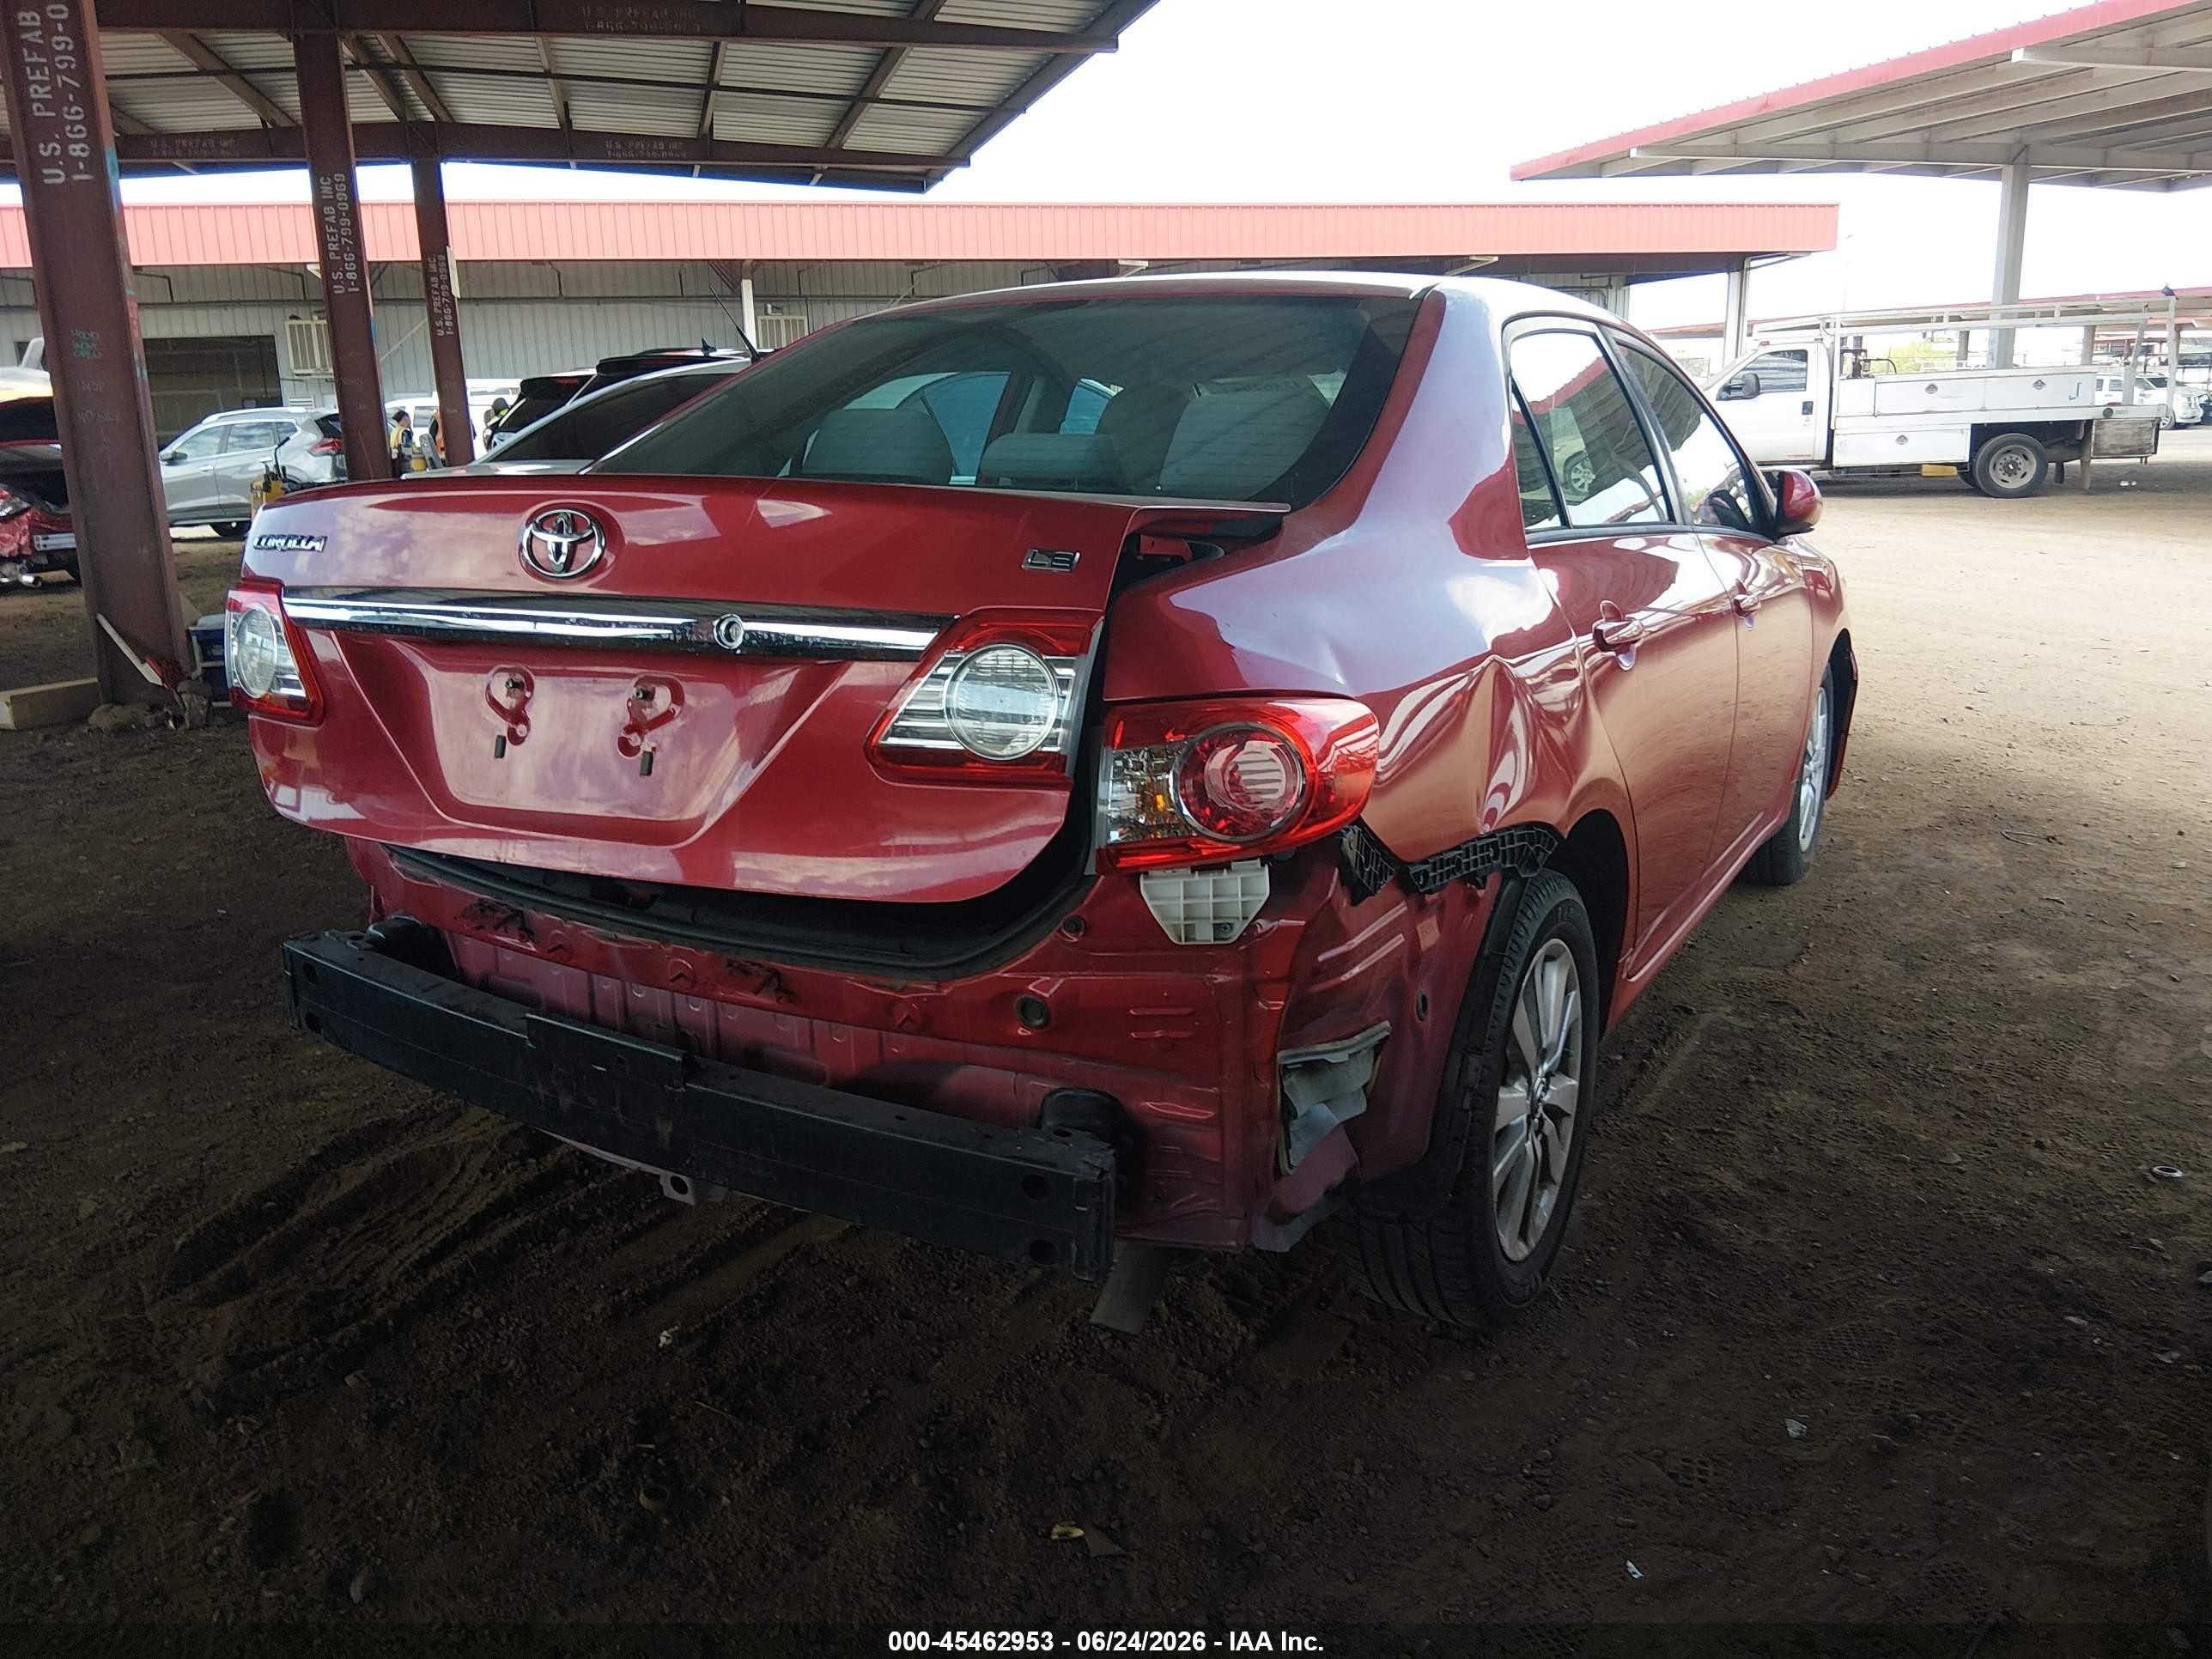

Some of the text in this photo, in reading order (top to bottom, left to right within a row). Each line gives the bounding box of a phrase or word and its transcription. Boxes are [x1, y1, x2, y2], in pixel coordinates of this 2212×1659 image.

[17, 10, 66, 185] U.S. PREFAB
[323, 206, 341, 260] PREFAB
[333, 173, 360, 293] 1-866-799-0969
[331, 267, 346, 294] U.S.
[430, 276, 442, 313] PREFAB
